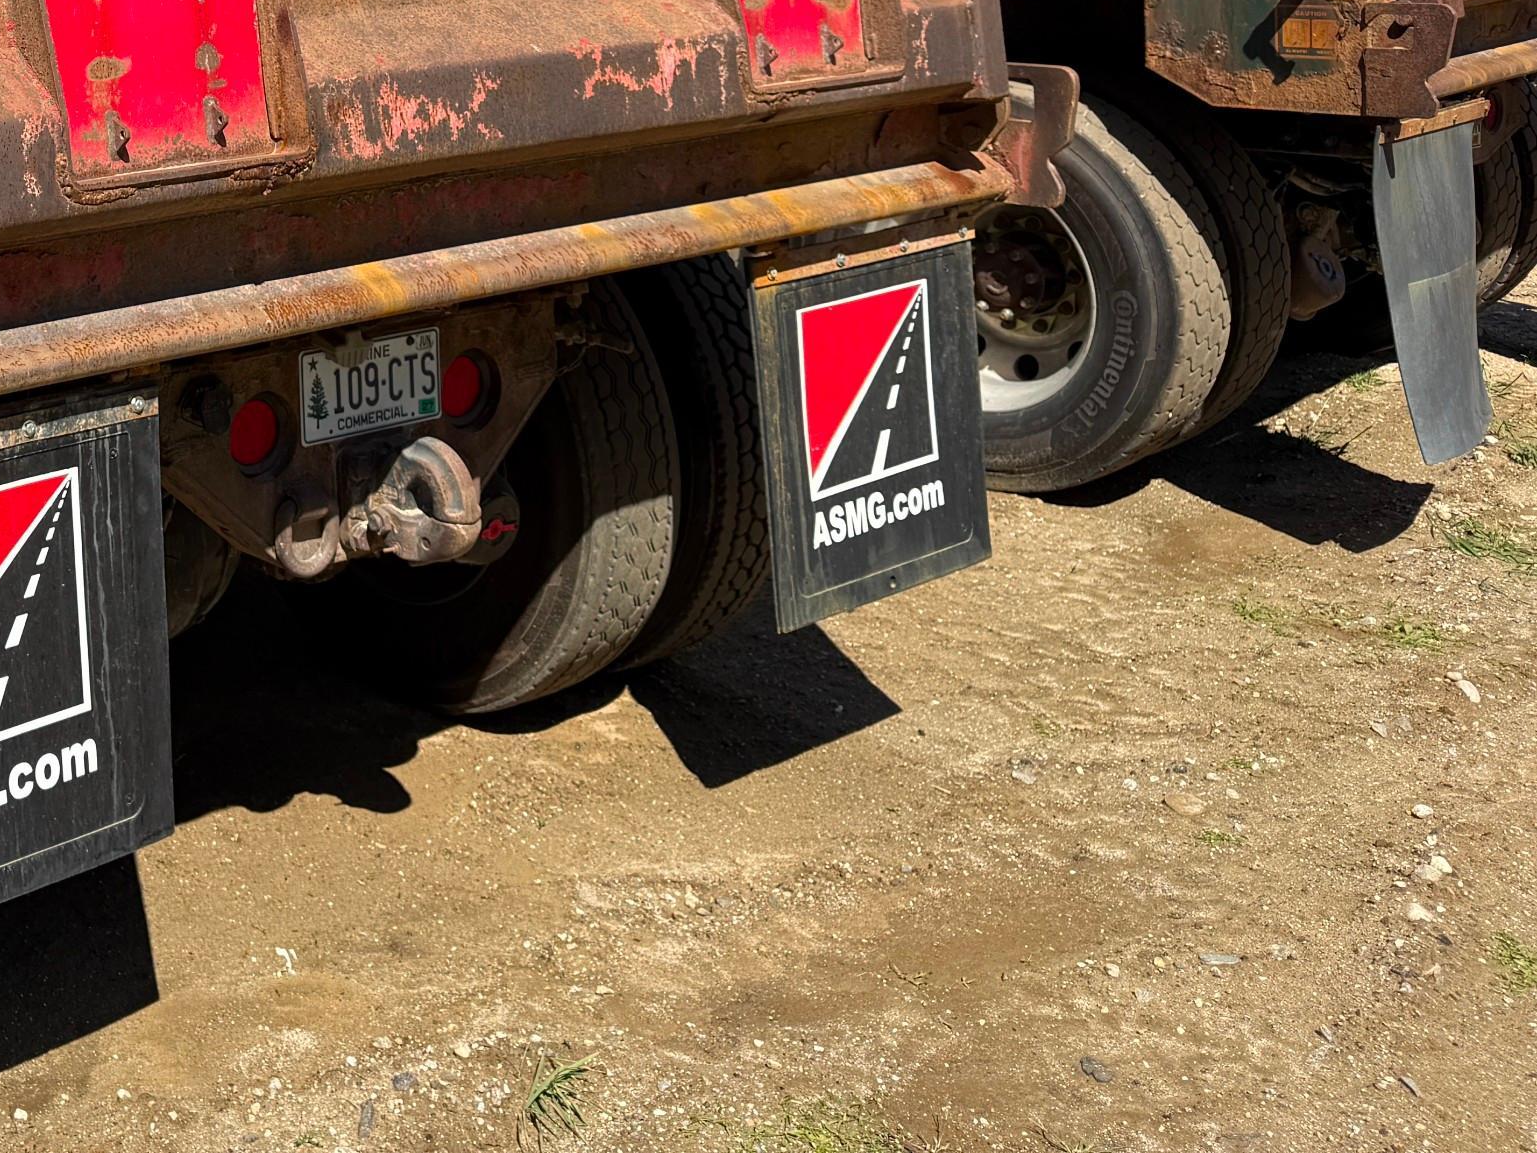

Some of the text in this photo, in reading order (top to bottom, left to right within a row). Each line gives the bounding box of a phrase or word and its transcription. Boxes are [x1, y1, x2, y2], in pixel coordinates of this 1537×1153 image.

[367, 345, 390, 361] INE
[1074, 289, 1140, 432] Continental
[337, 406, 408, 431] COMMERCIAL
[813, 479, 946, 550] ASMG.com
